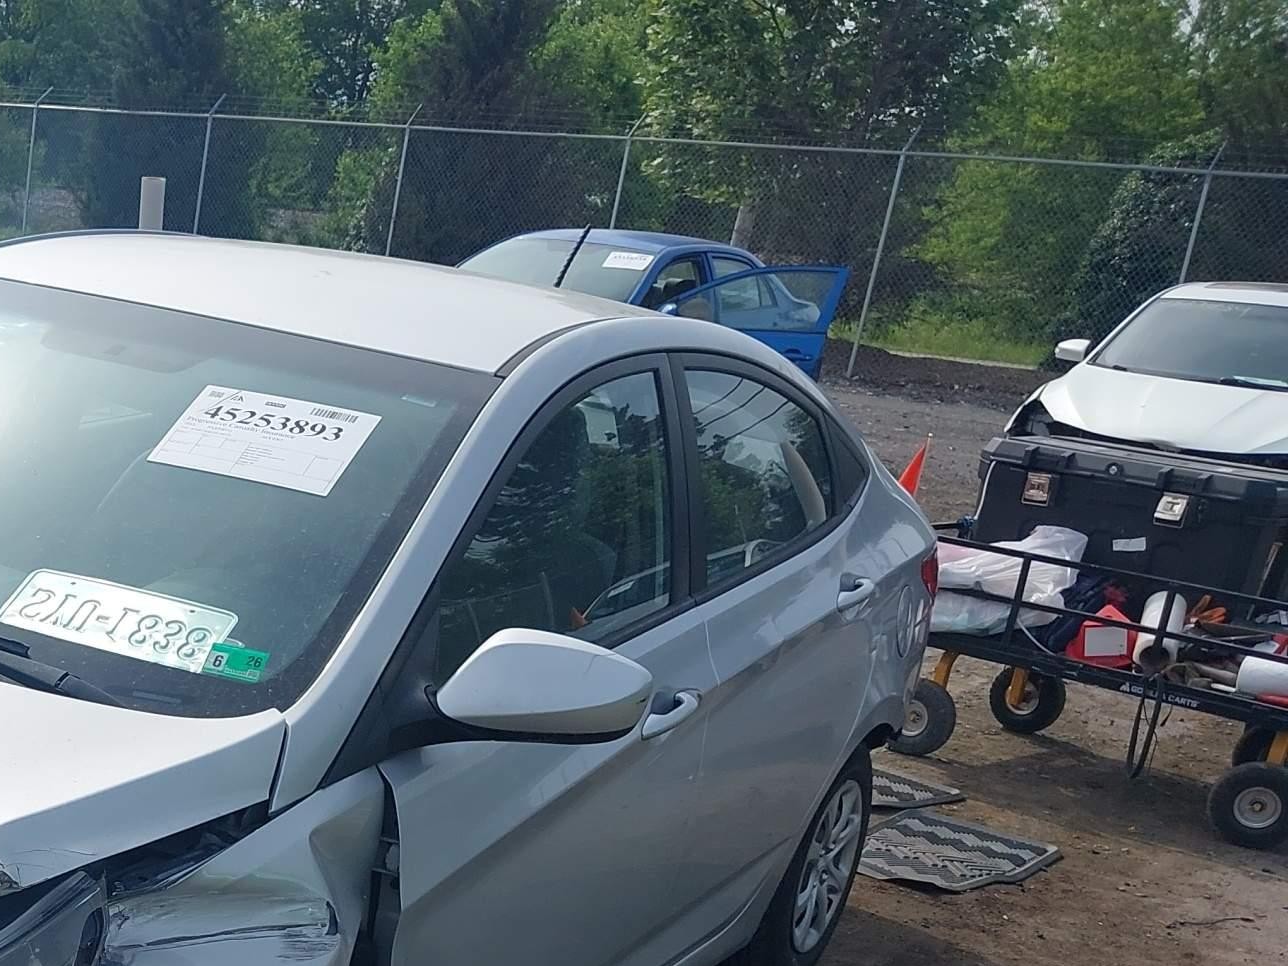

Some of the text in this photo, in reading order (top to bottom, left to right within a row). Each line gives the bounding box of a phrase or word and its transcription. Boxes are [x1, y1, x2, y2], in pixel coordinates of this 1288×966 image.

[204, 405, 344, 441] 45253893
[212, 655, 263, 668] 6 26
